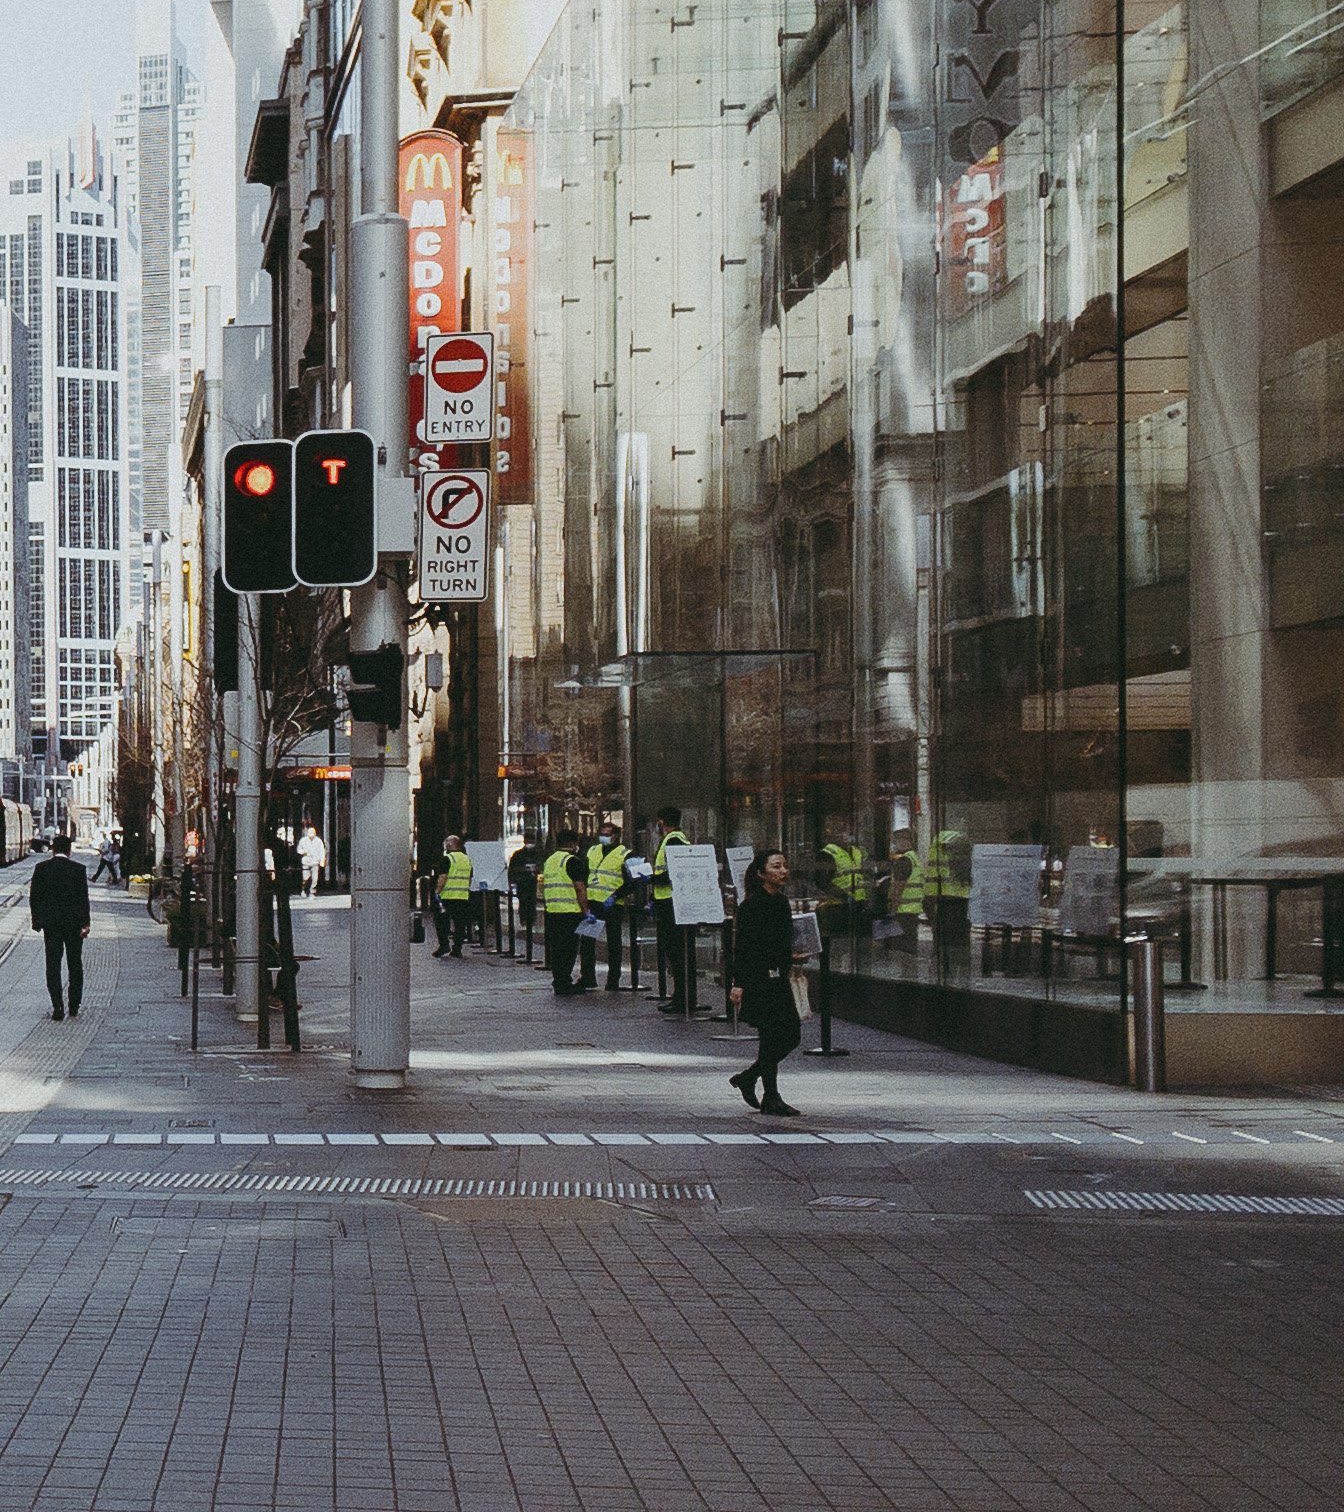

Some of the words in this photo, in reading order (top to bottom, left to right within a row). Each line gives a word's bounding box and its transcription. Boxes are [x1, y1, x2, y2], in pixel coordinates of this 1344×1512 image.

[444, 399, 474, 416] NO
[431, 419, 486, 435] ENTRY
[436, 535, 472, 555] NO
[427, 559, 479, 575] RIGHT
[429, 578, 478, 593] TURN
